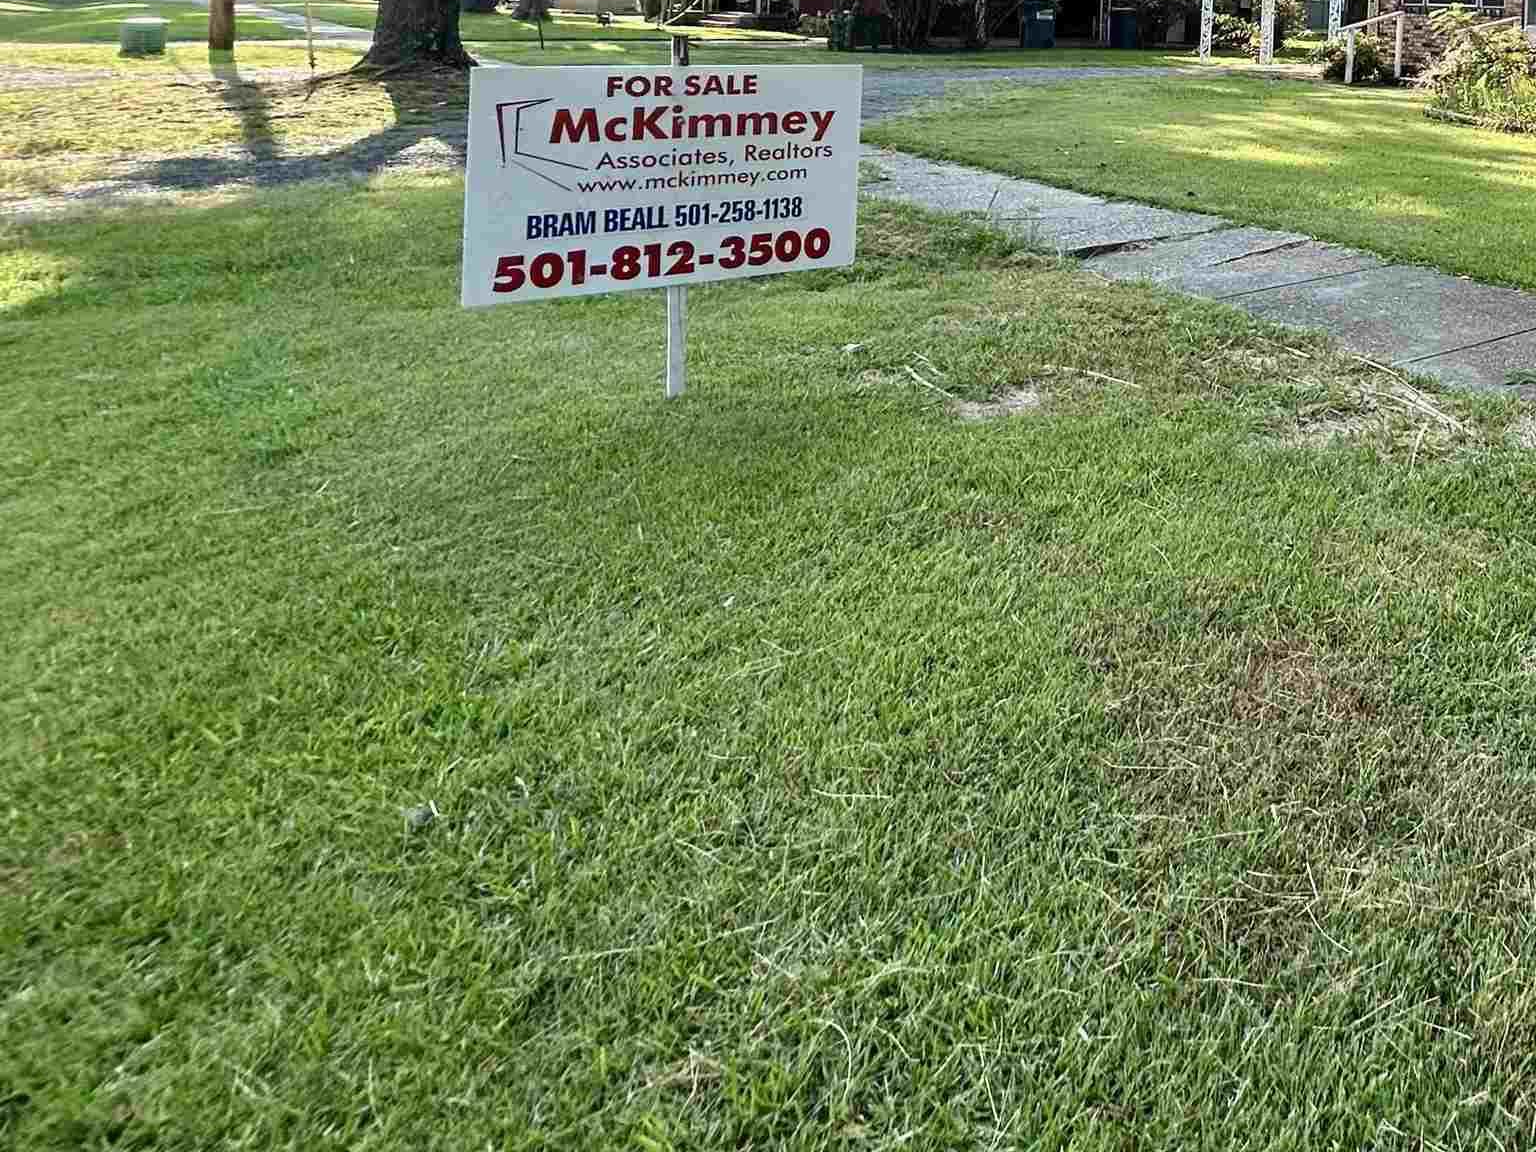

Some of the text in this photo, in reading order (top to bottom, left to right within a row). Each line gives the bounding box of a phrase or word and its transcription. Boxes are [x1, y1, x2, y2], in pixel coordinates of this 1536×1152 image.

[606, 74, 758, 97] FOR SALE
[549, 105, 836, 143] McKimmey
[595, 142, 833, 170] Associates, Realtors
[577, 167, 807, 193] www.mckimmey.com
[526, 196, 802, 239] BRAM BEALL 501-258-1138
[492, 228, 831, 293] 501-812-3500
